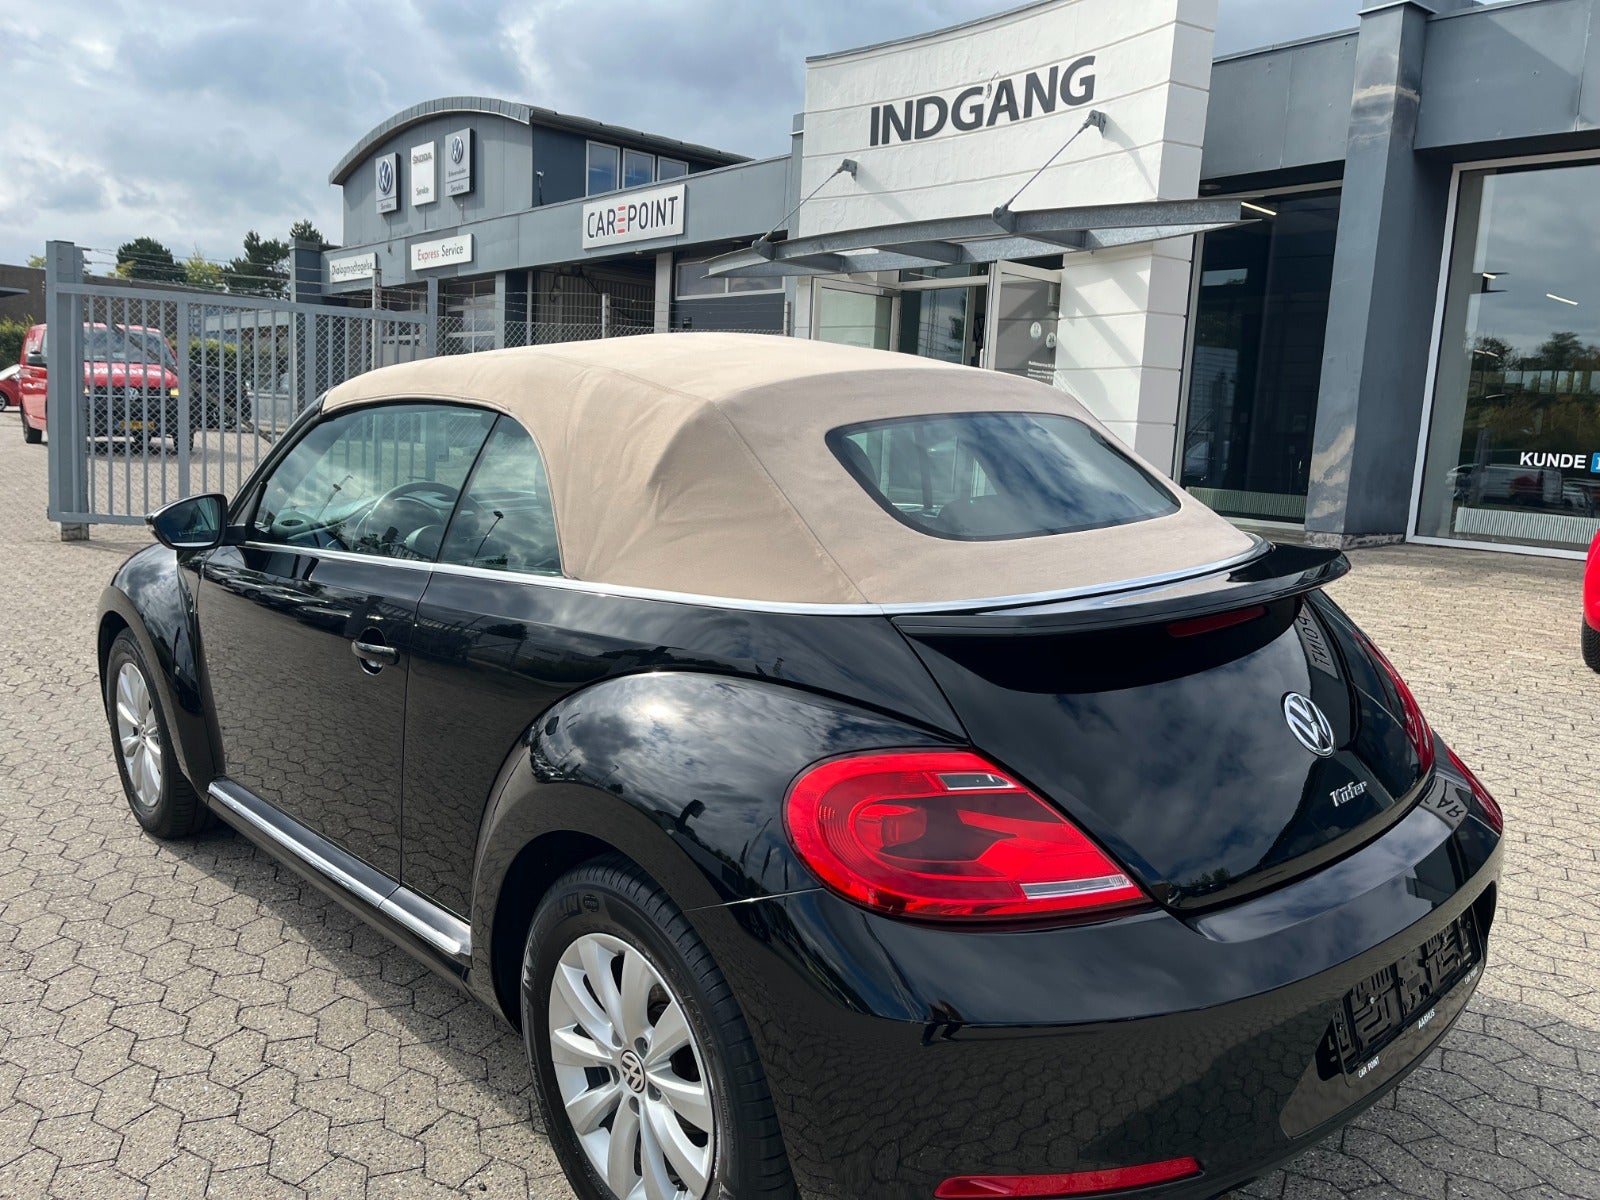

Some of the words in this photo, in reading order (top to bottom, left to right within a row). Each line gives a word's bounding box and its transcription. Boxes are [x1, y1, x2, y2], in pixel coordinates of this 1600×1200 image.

[870, 56, 1095, 146] INDGANG
[417, 249, 440, 262] Express
[441, 243, 463, 257] Service
[1520, 452, 1587, 469] KUNDE
